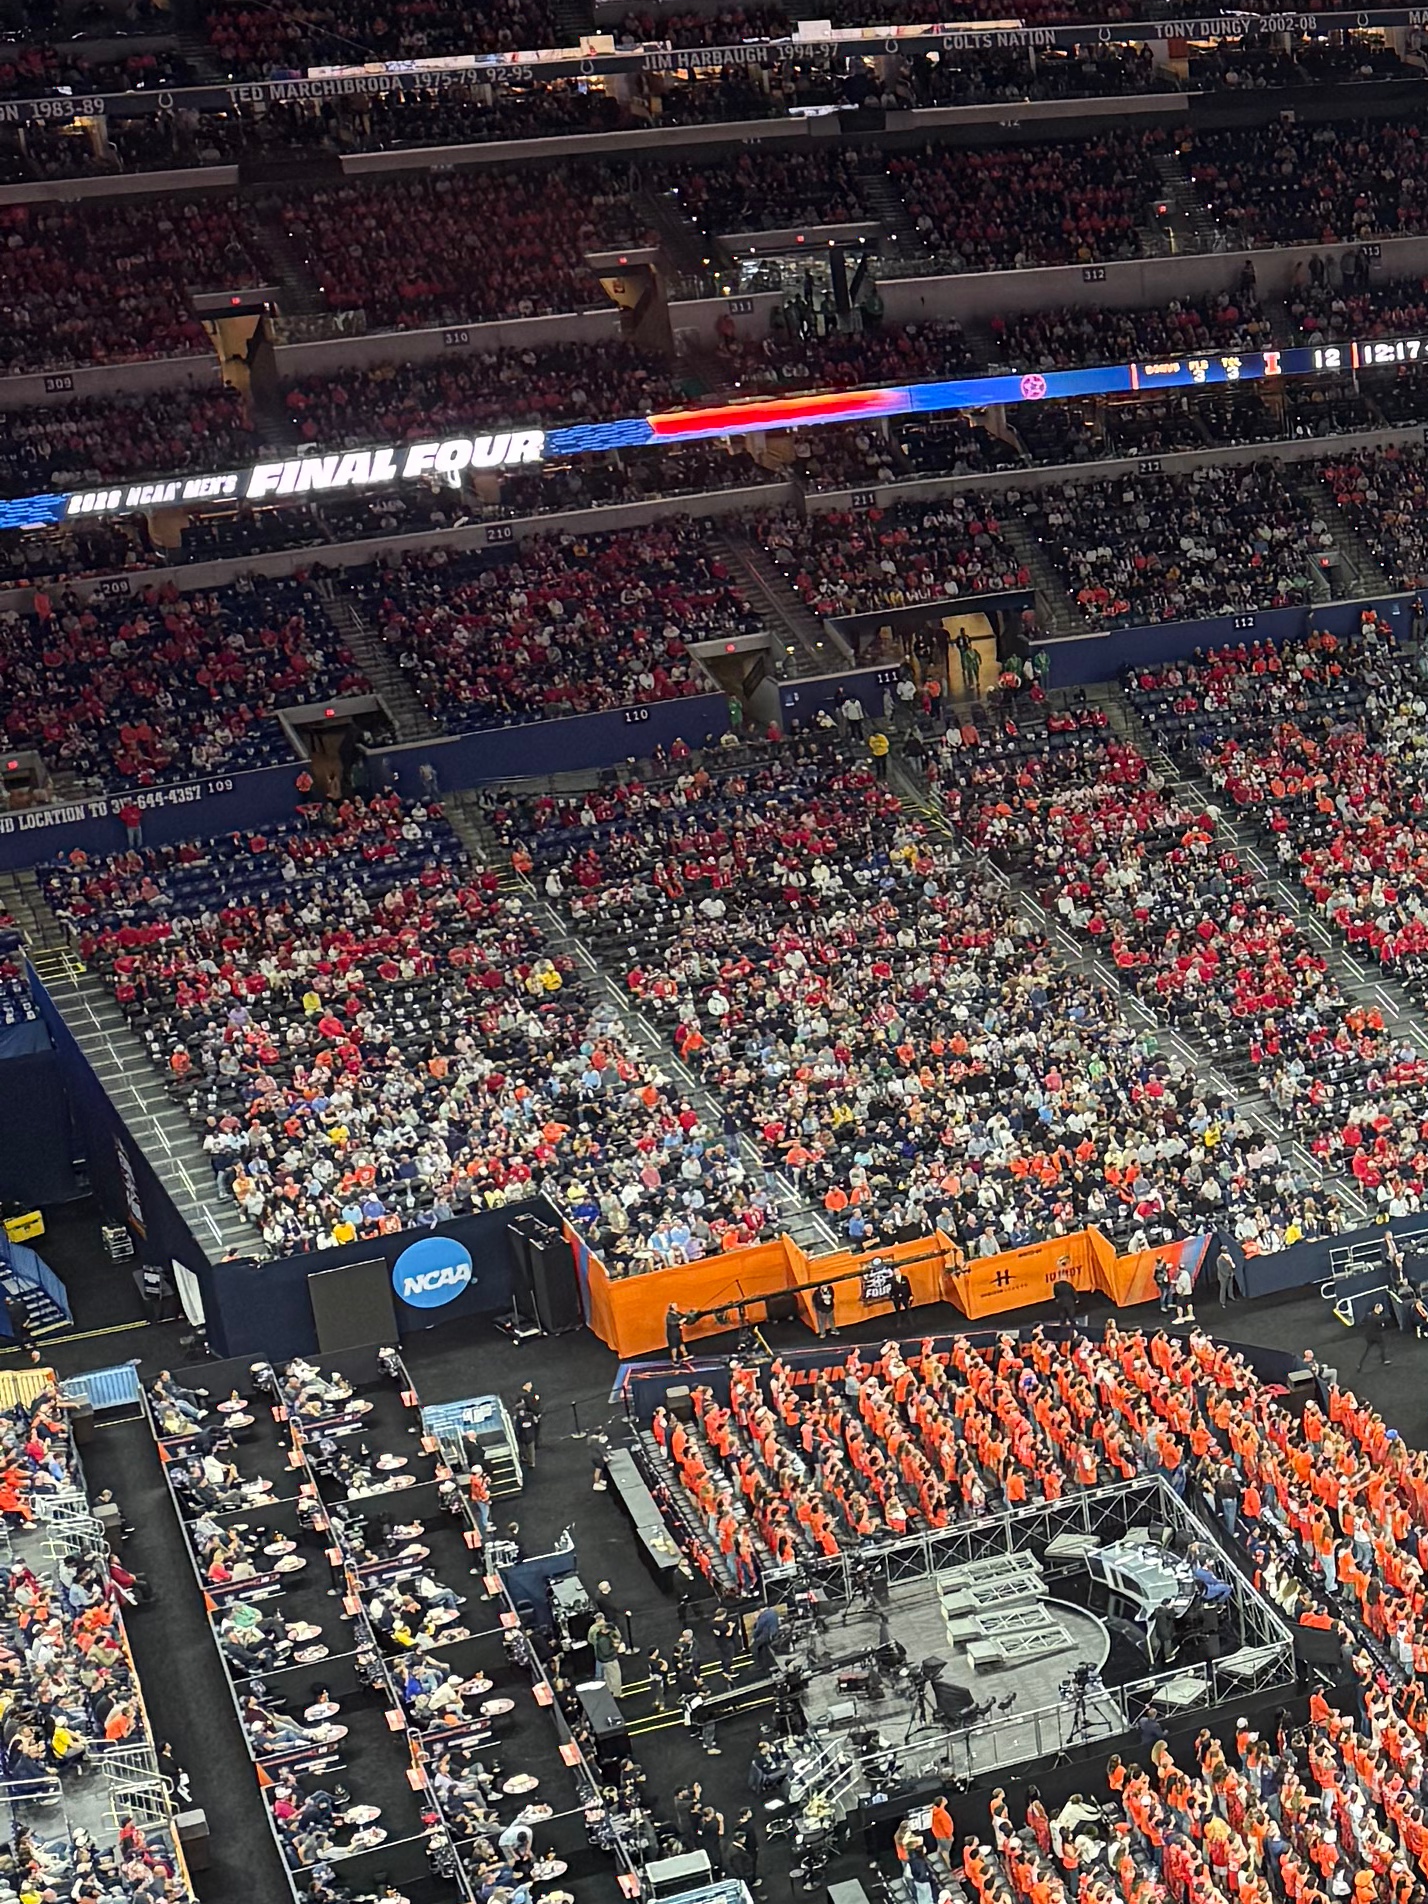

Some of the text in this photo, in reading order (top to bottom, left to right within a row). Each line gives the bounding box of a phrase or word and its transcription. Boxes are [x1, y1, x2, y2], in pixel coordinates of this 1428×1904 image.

[1154, 17, 1318, 39] TONY DUNGY 2002-08
[943, 29, 1056, 51] COLTS NATION
[642, 43, 839, 71] JIM HARBAUGH 1994-97
[226, 65, 533, 102] TED MARCHIBRODA 92-95
[30, 98, 105, 119] 1983-89
[1084, 269, 1105, 281] 312
[731, 301, 752, 313] 311
[445, 331, 469, 345] 310
[1314, 347, 1341, 369] 12
[1363, 339, 1421, 364] 12:17
[45, 377, 72, 392] 309
[65, 490, 120, 517] 2026
[183, 473, 238, 499] MEN'S
[245, 446, 399, 500] FINAL
[402, 429, 546, 479] FOUR
[854, 494, 875, 507] 211
[487, 528, 512, 542] 210
[403, 1262, 472, 1297] NCAA
